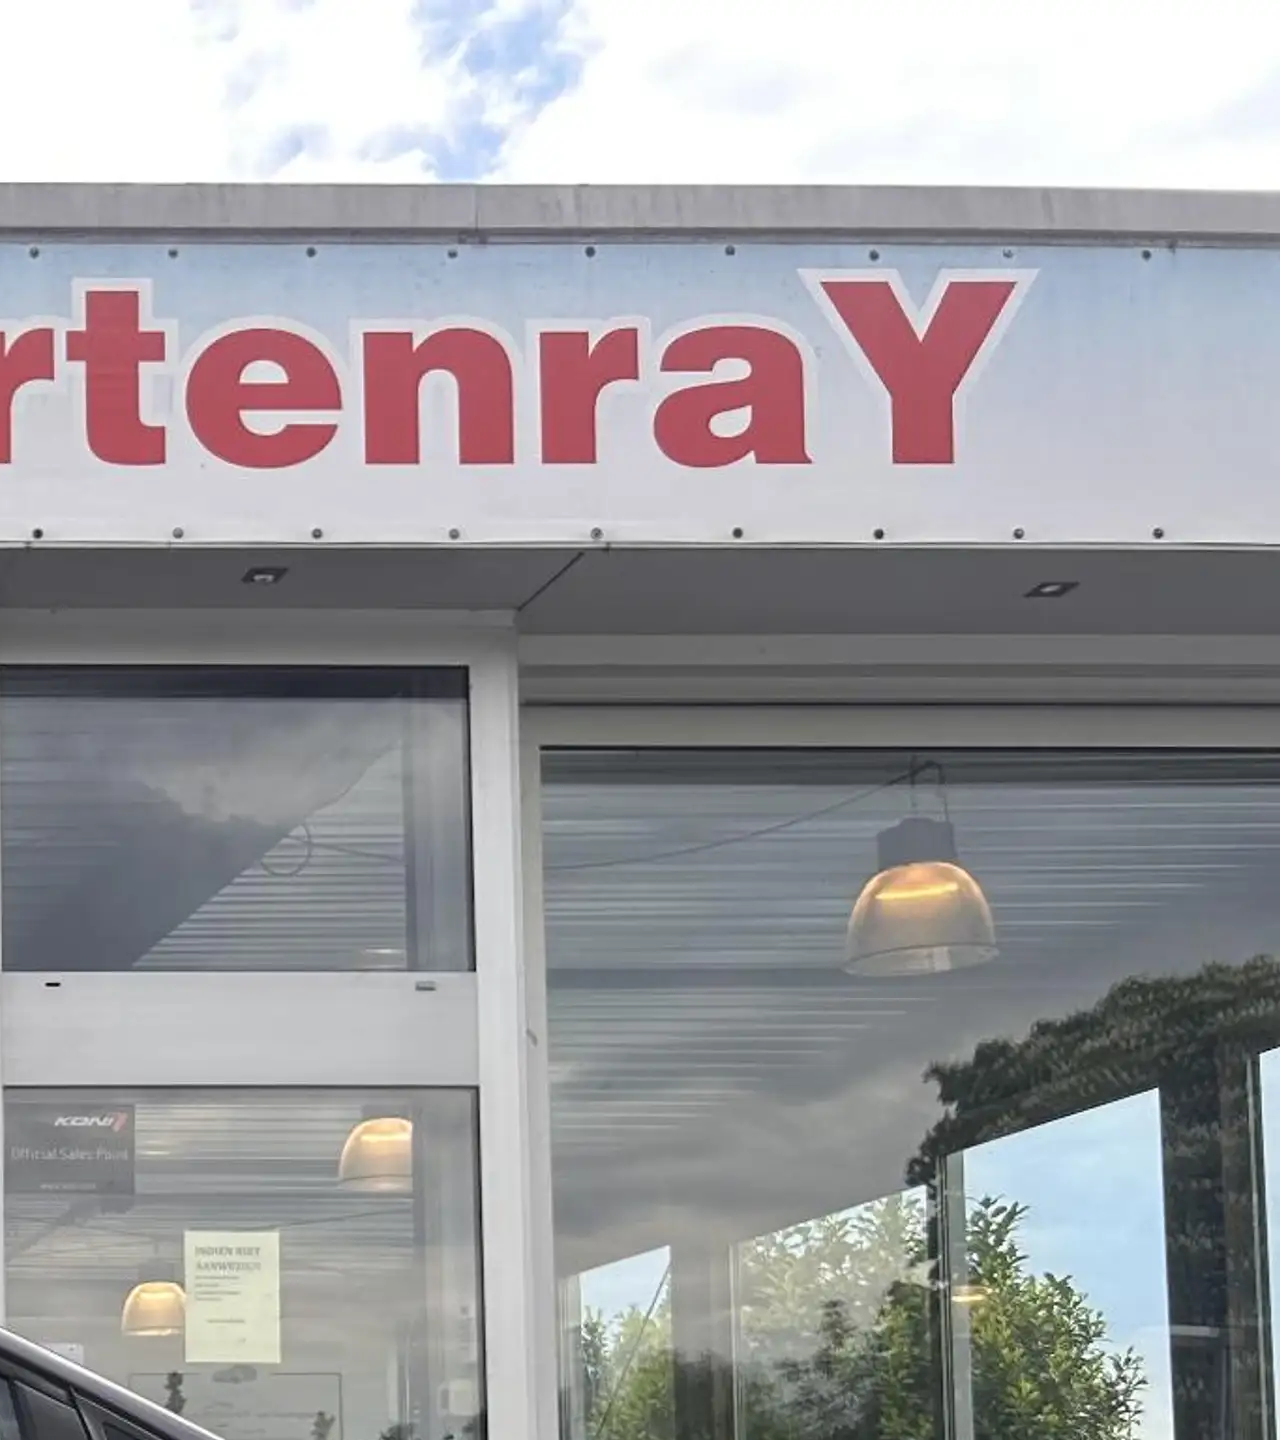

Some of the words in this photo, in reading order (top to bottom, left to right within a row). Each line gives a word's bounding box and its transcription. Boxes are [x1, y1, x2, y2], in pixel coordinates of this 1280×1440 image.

[53, 1116, 116, 1127] KONI
[10, 1145, 58, 1160] Official
[59, 1145, 96, 1160] Sales
[96, 1145, 129, 1160] Point
